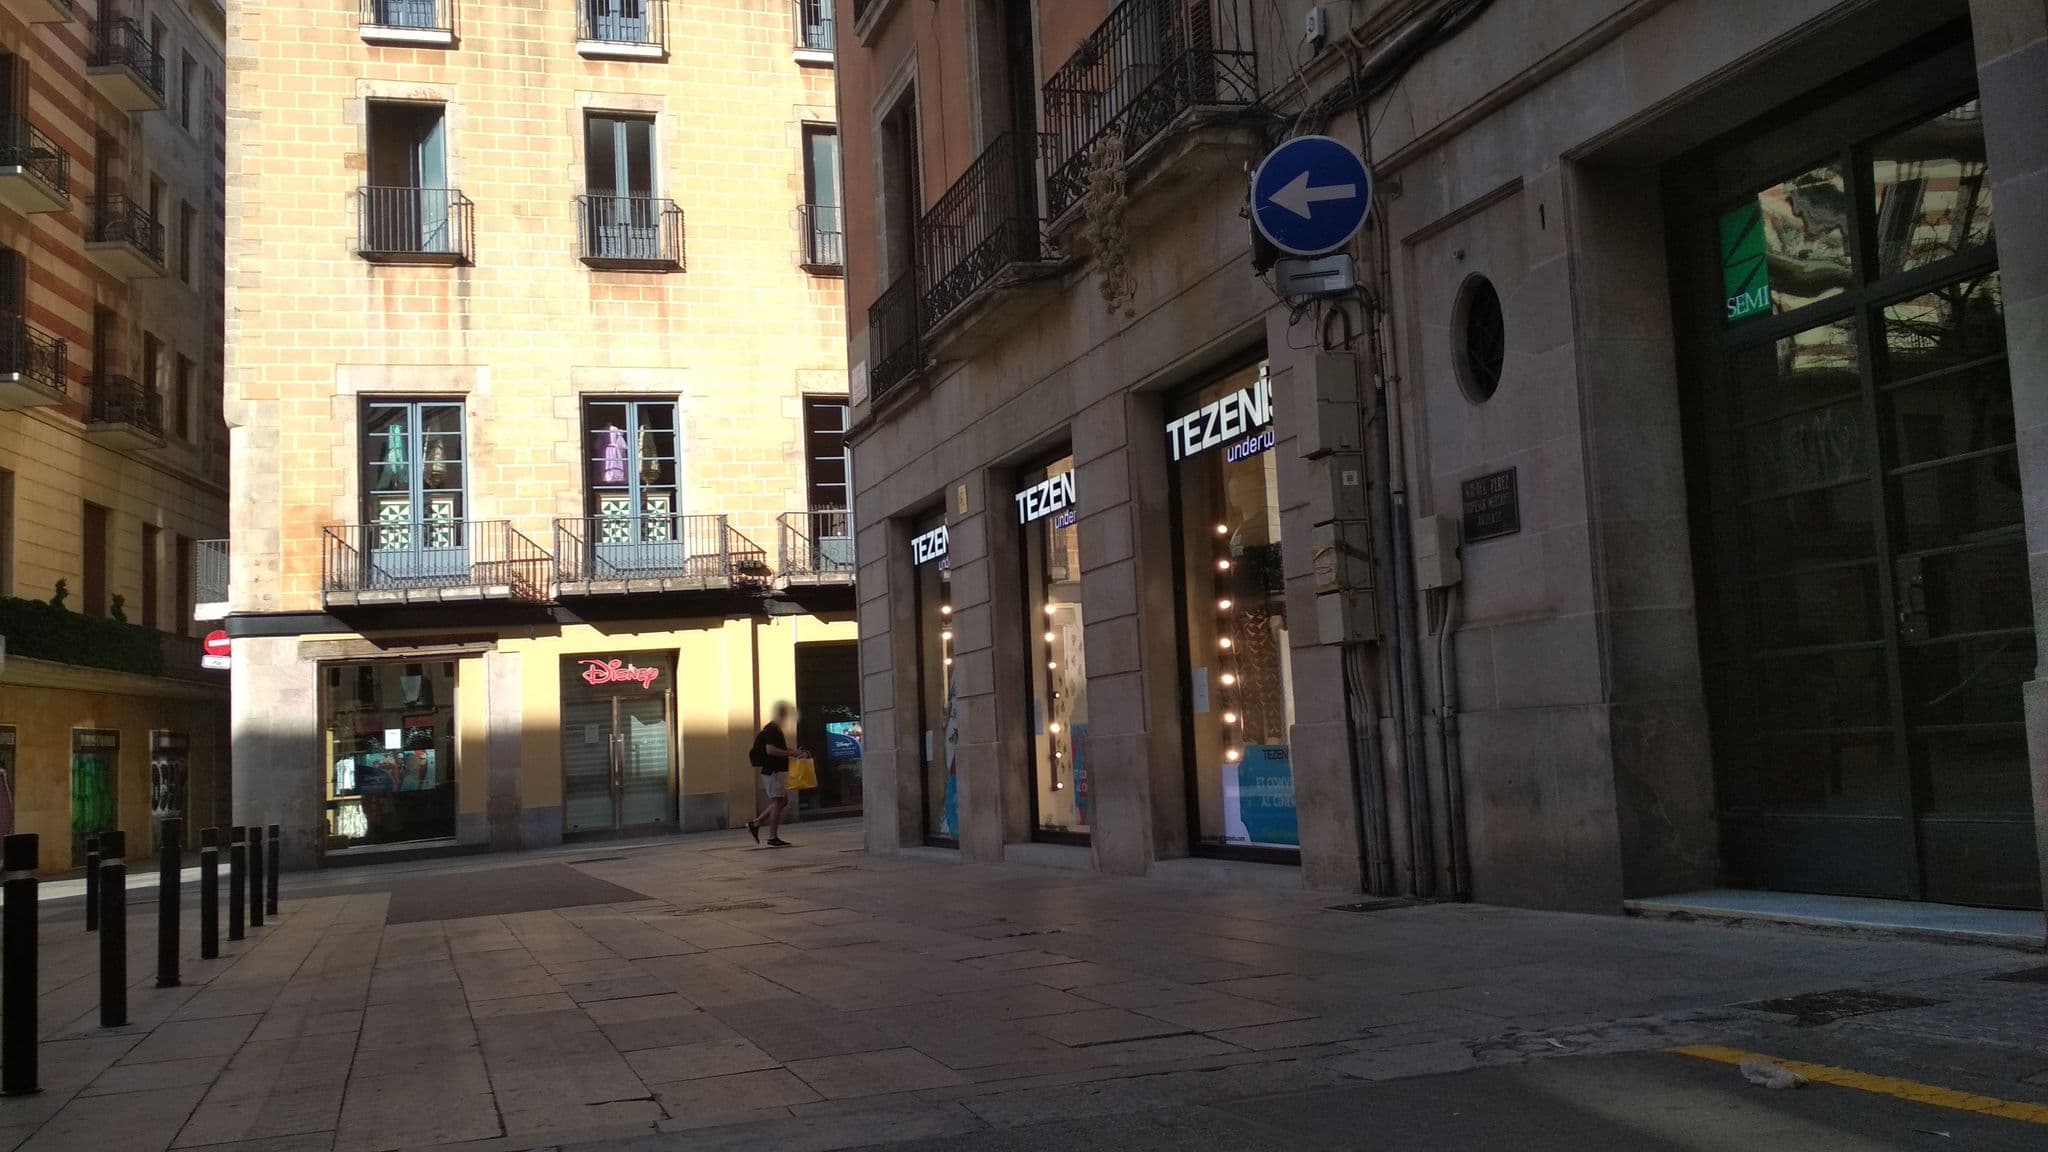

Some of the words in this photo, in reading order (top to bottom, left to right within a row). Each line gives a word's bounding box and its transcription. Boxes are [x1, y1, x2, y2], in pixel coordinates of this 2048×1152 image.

[1727, 285, 1770, 318] SEMI
[1015, 468, 1076, 524] TEZEN
[1055, 509, 1077, 528] under
[578, 659, 659, 689] Disney
